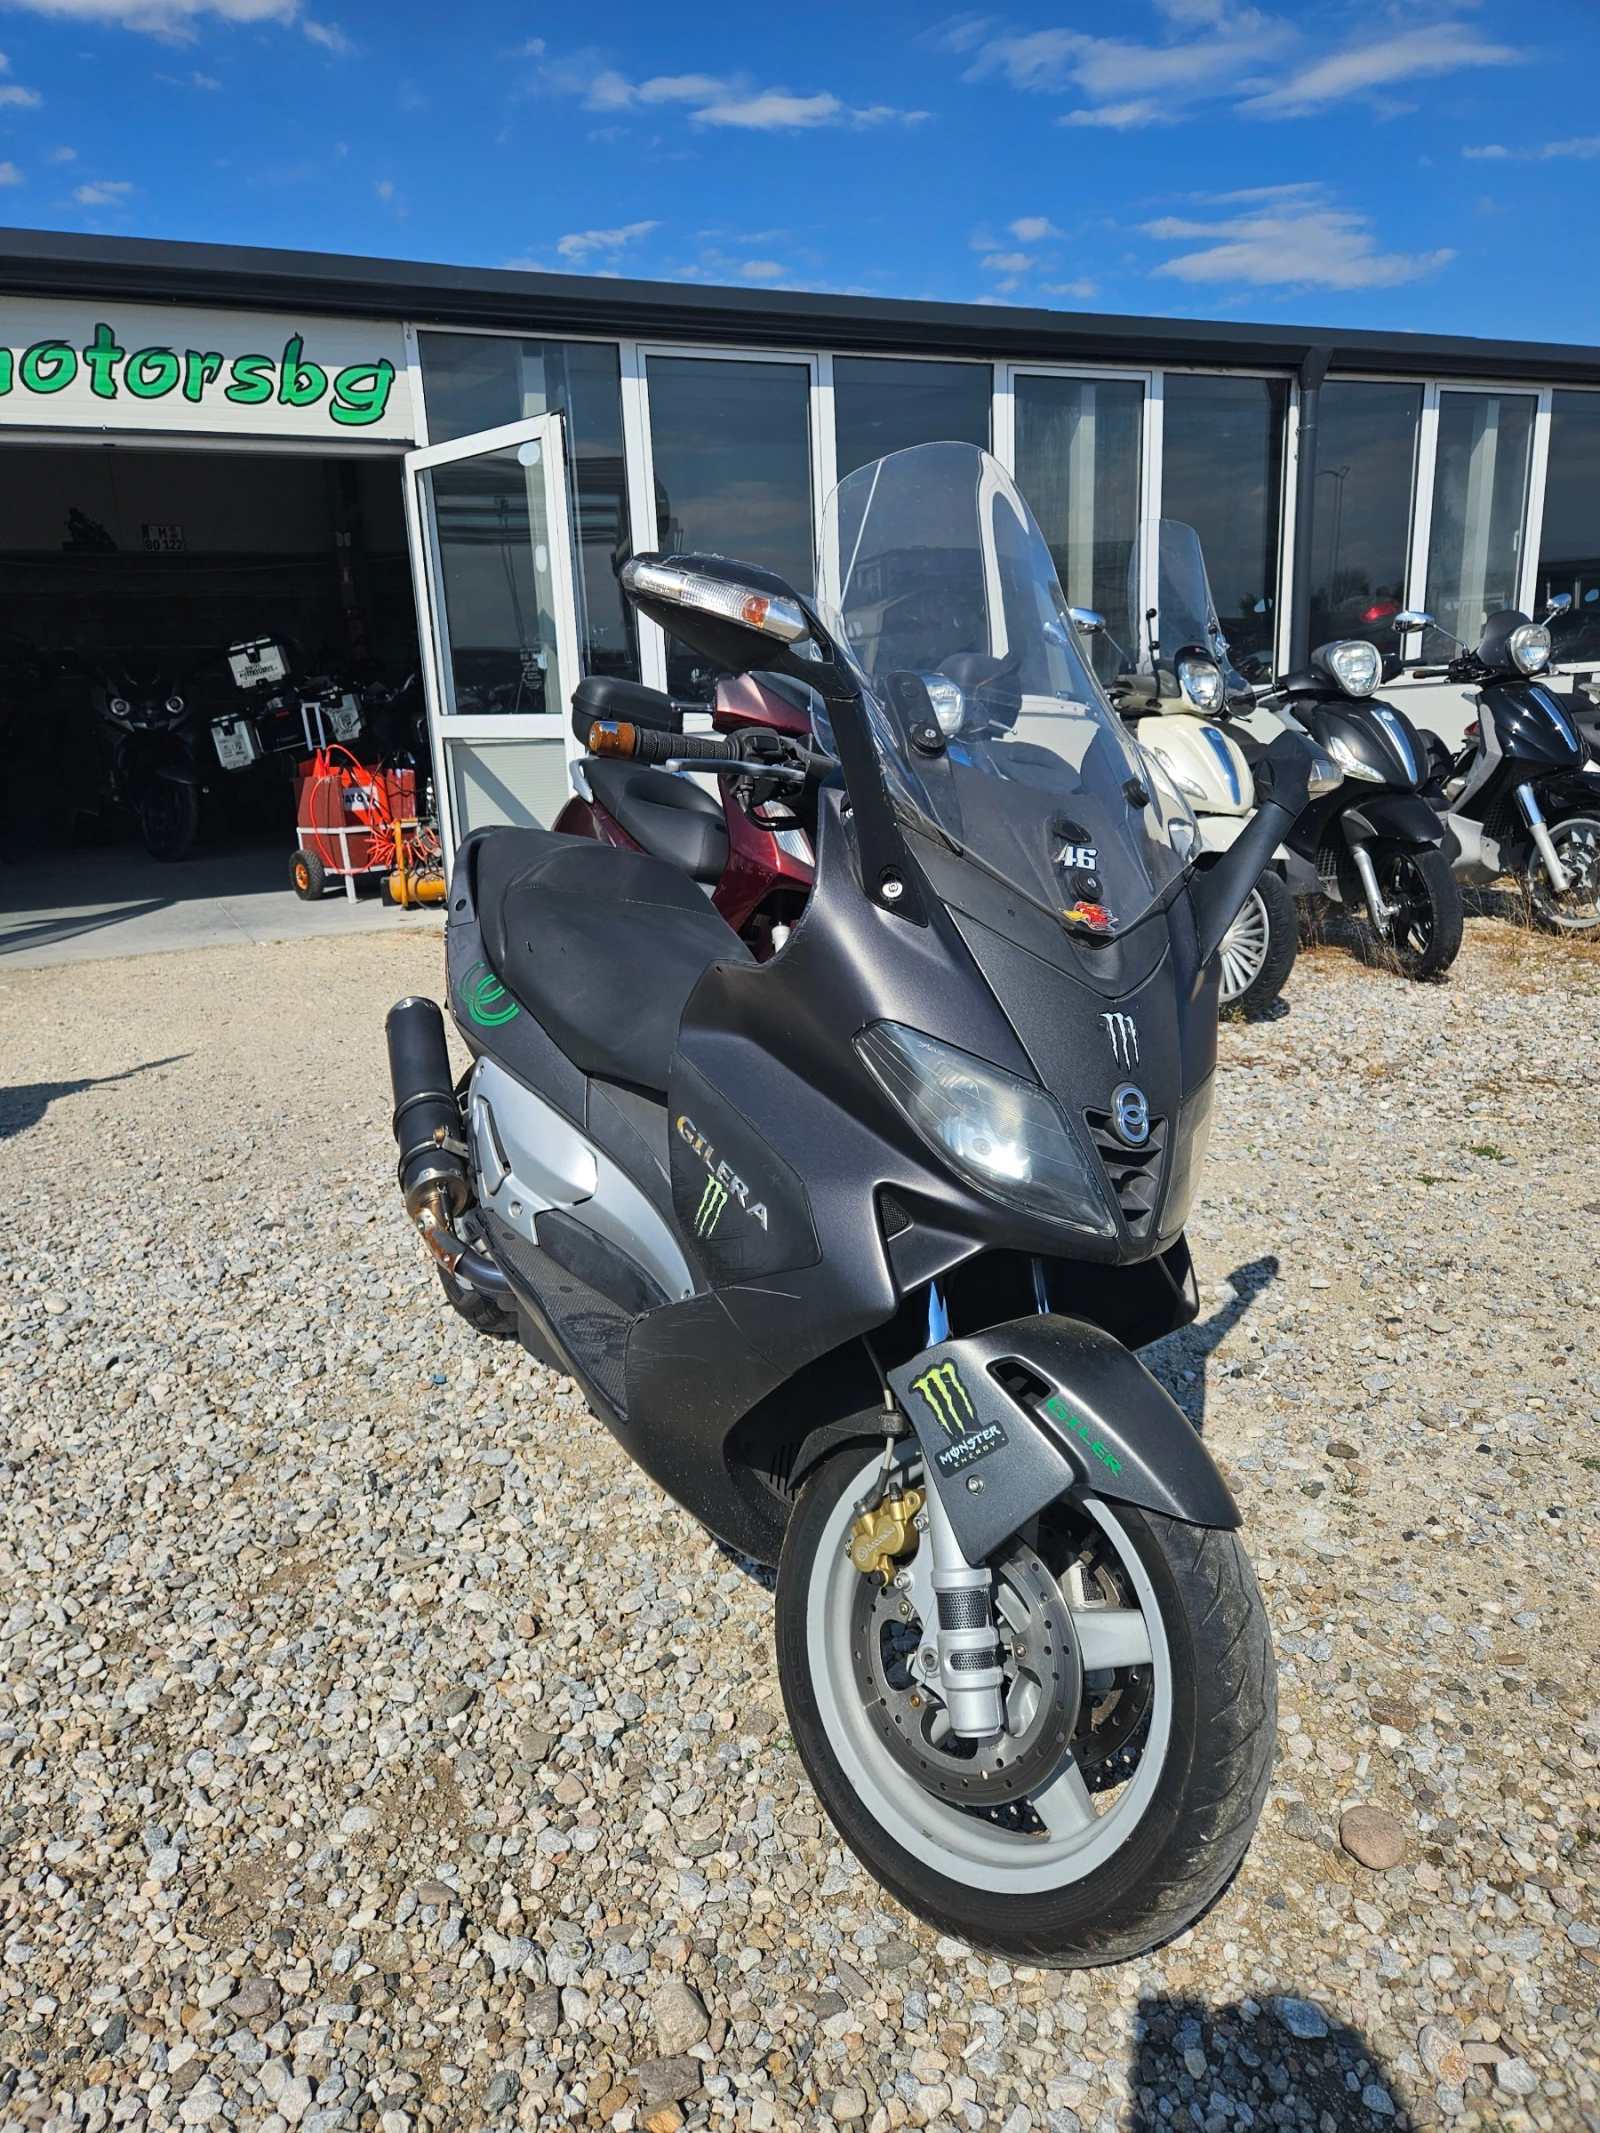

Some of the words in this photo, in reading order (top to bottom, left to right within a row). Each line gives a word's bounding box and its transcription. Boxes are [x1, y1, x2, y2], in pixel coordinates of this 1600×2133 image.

[158, 527, 168, 539] M
[163, 540, 184, 550] 122
[343, 793, 364, 803] ATO
[1055, 844, 1099, 871] 46
[677, 1116, 767, 1231] GILERA
[939, 1424, 1001, 1465] MONSTER
[1046, 1398, 1122, 1477] GILER
[953, 1440, 996, 1468] ENERGY
